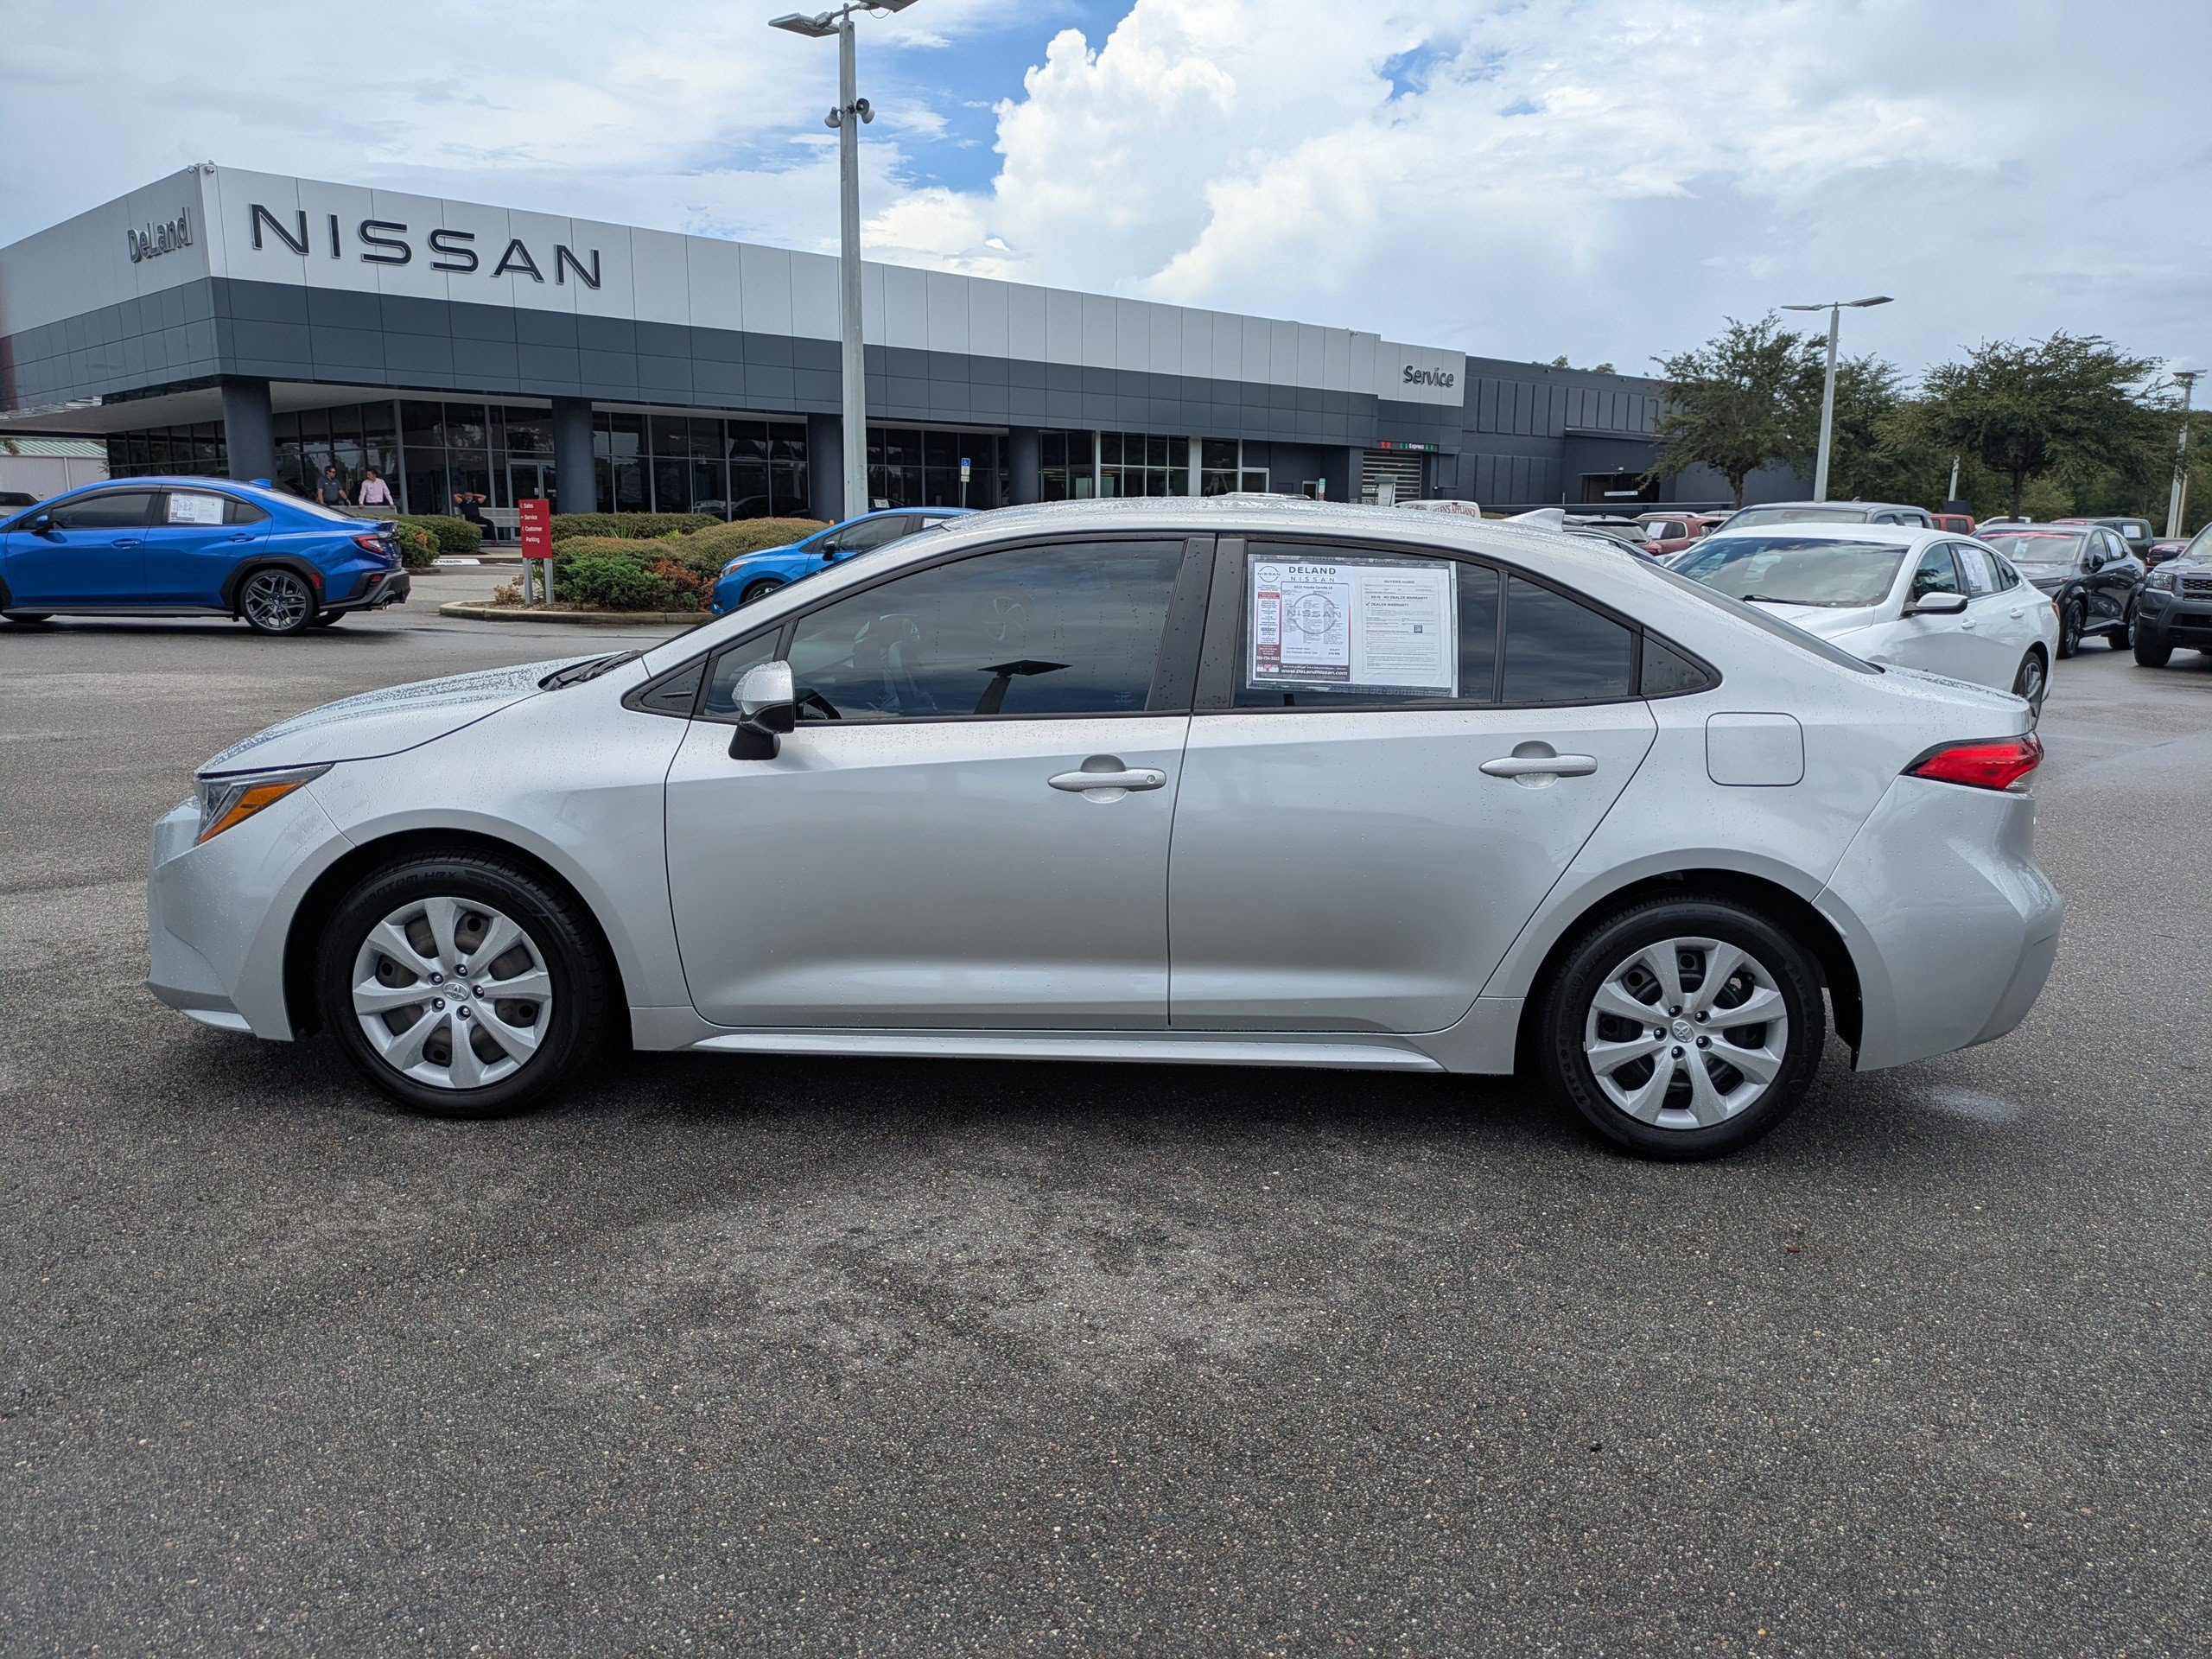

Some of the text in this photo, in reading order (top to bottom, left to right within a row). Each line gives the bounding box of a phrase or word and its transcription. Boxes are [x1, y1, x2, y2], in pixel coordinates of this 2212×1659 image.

[127, 207, 193, 262] DeLand
[249, 203, 601, 289] NISSAN
[1403, 365, 1454, 388] Service
[1288, 566, 1337, 575] DELAND
